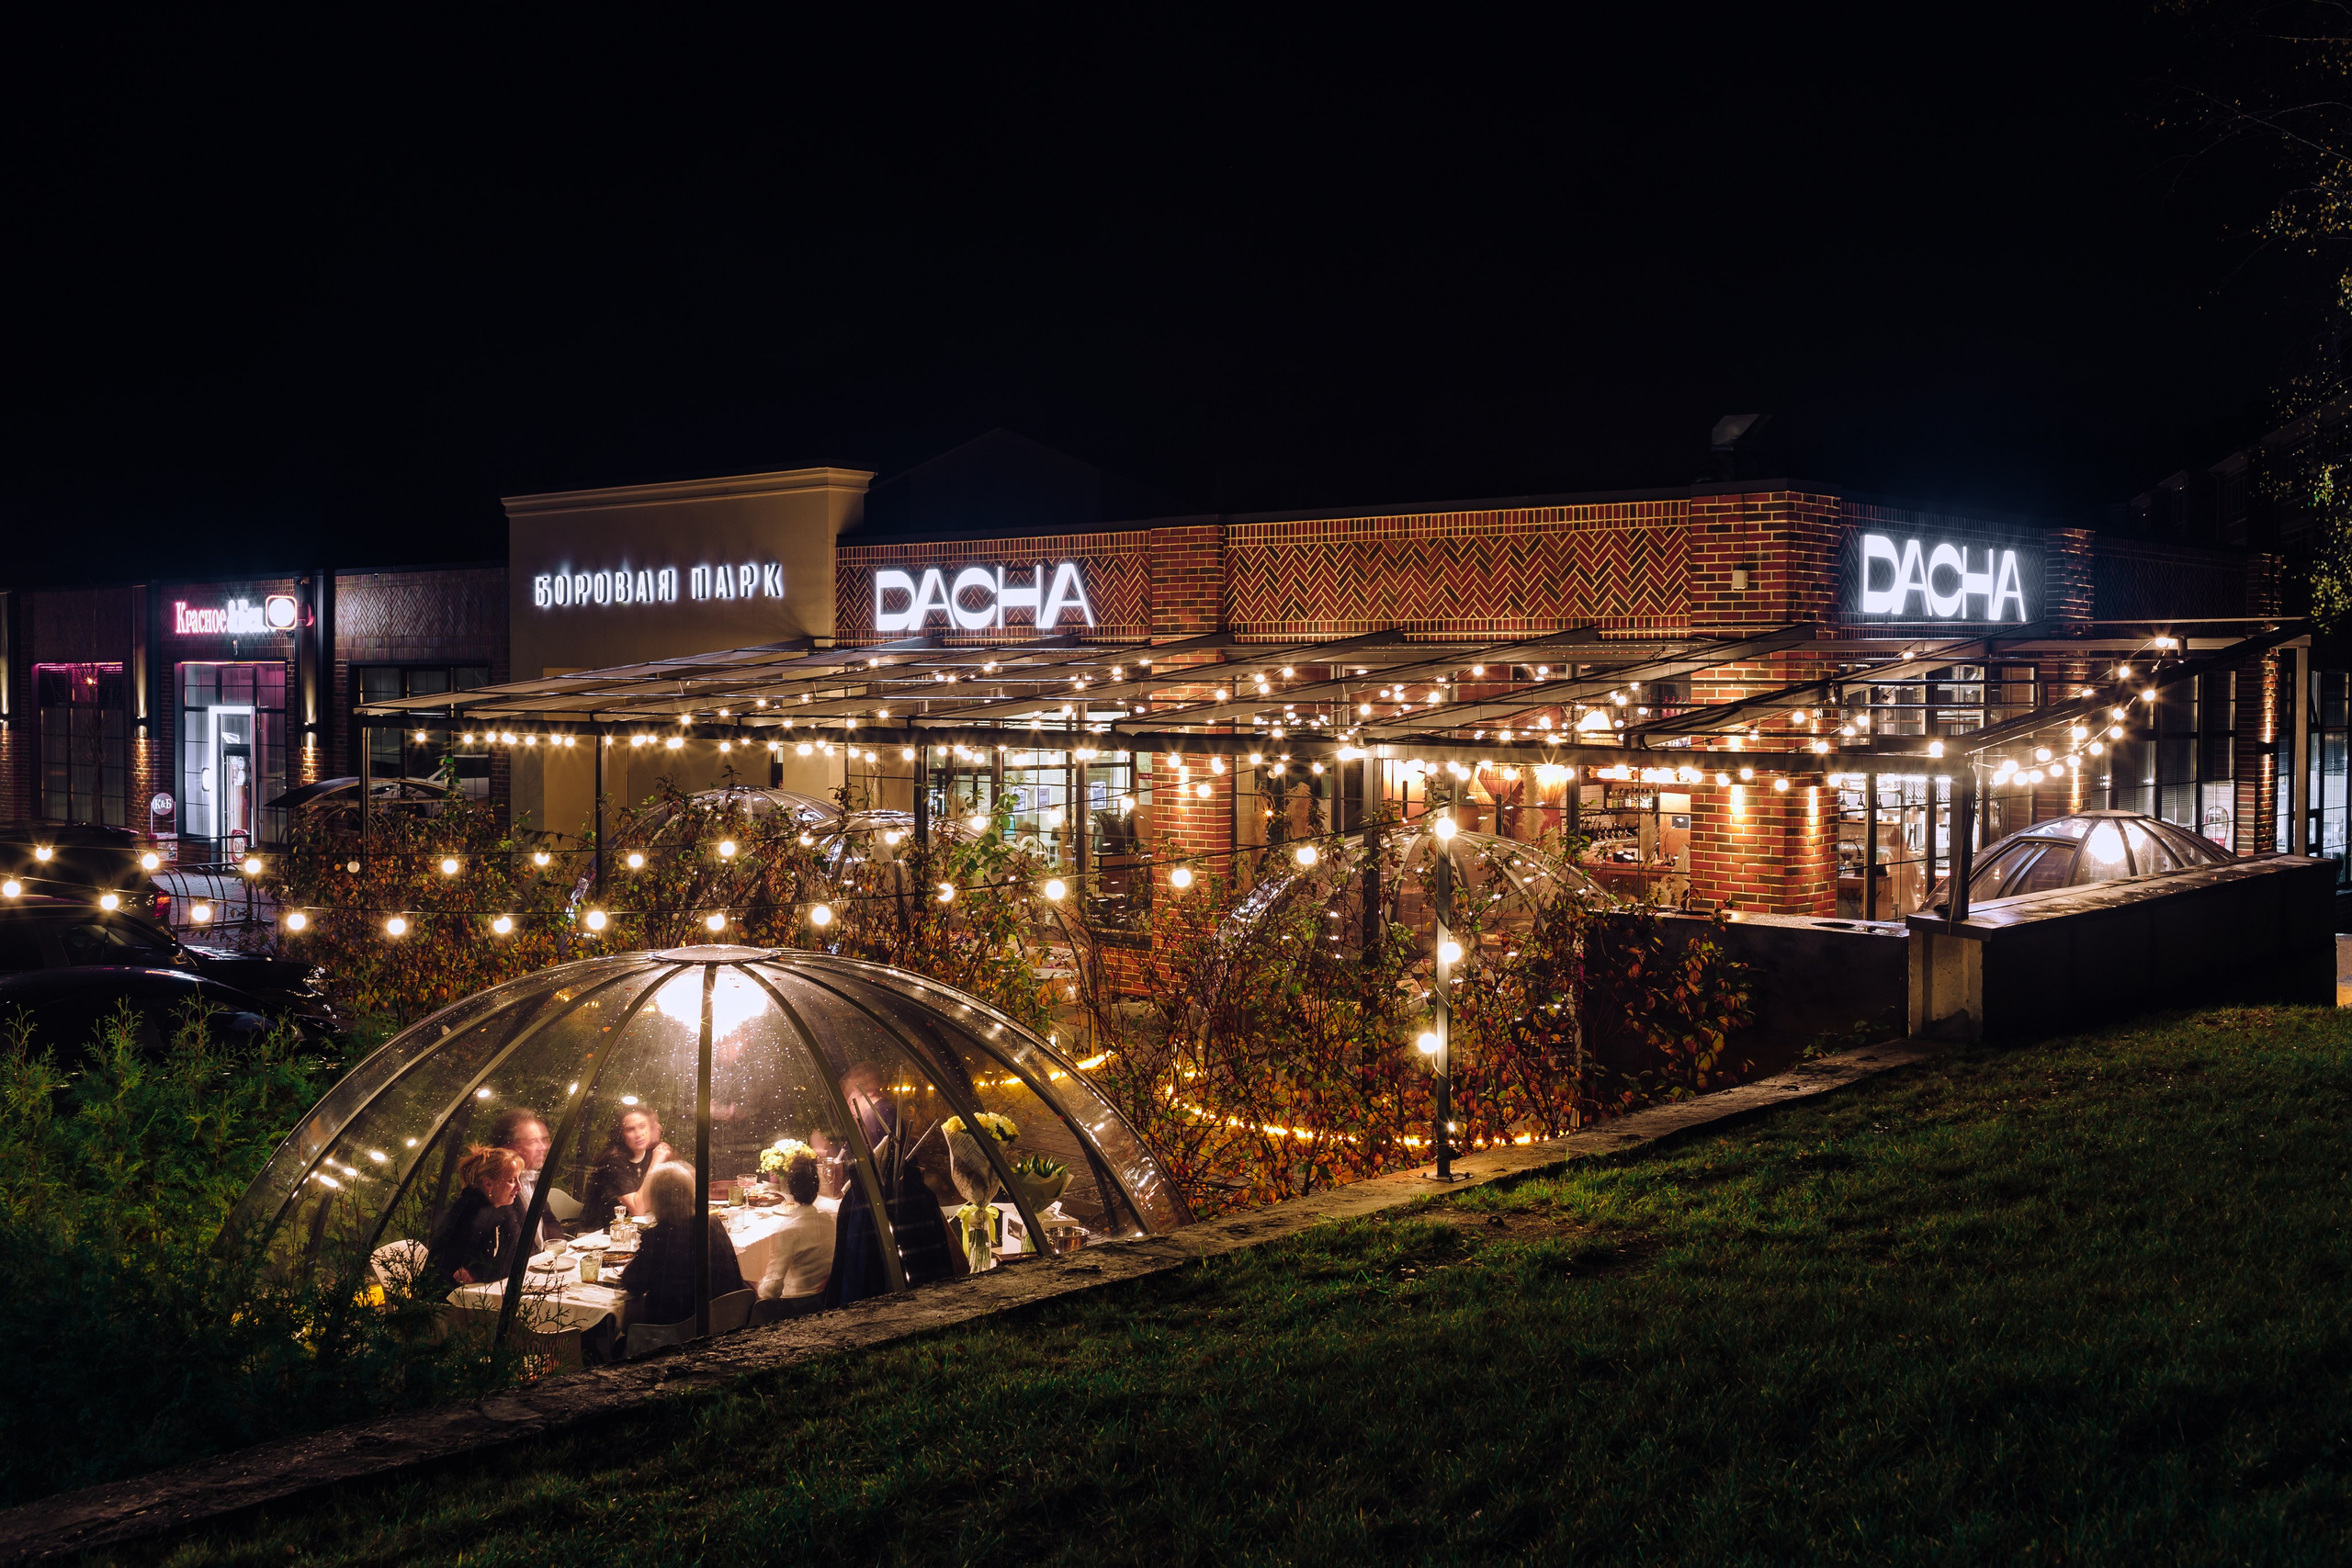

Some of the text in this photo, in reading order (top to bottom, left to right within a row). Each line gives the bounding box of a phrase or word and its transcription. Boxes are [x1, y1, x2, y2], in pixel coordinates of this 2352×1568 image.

[535, 564, 782, 606] БОРОВАЯ ПАРК
[876, 563, 1095, 632] DACHA
[1861, 534, 2027, 623] DACHA
[154, 798, 173, 809] К&Б
